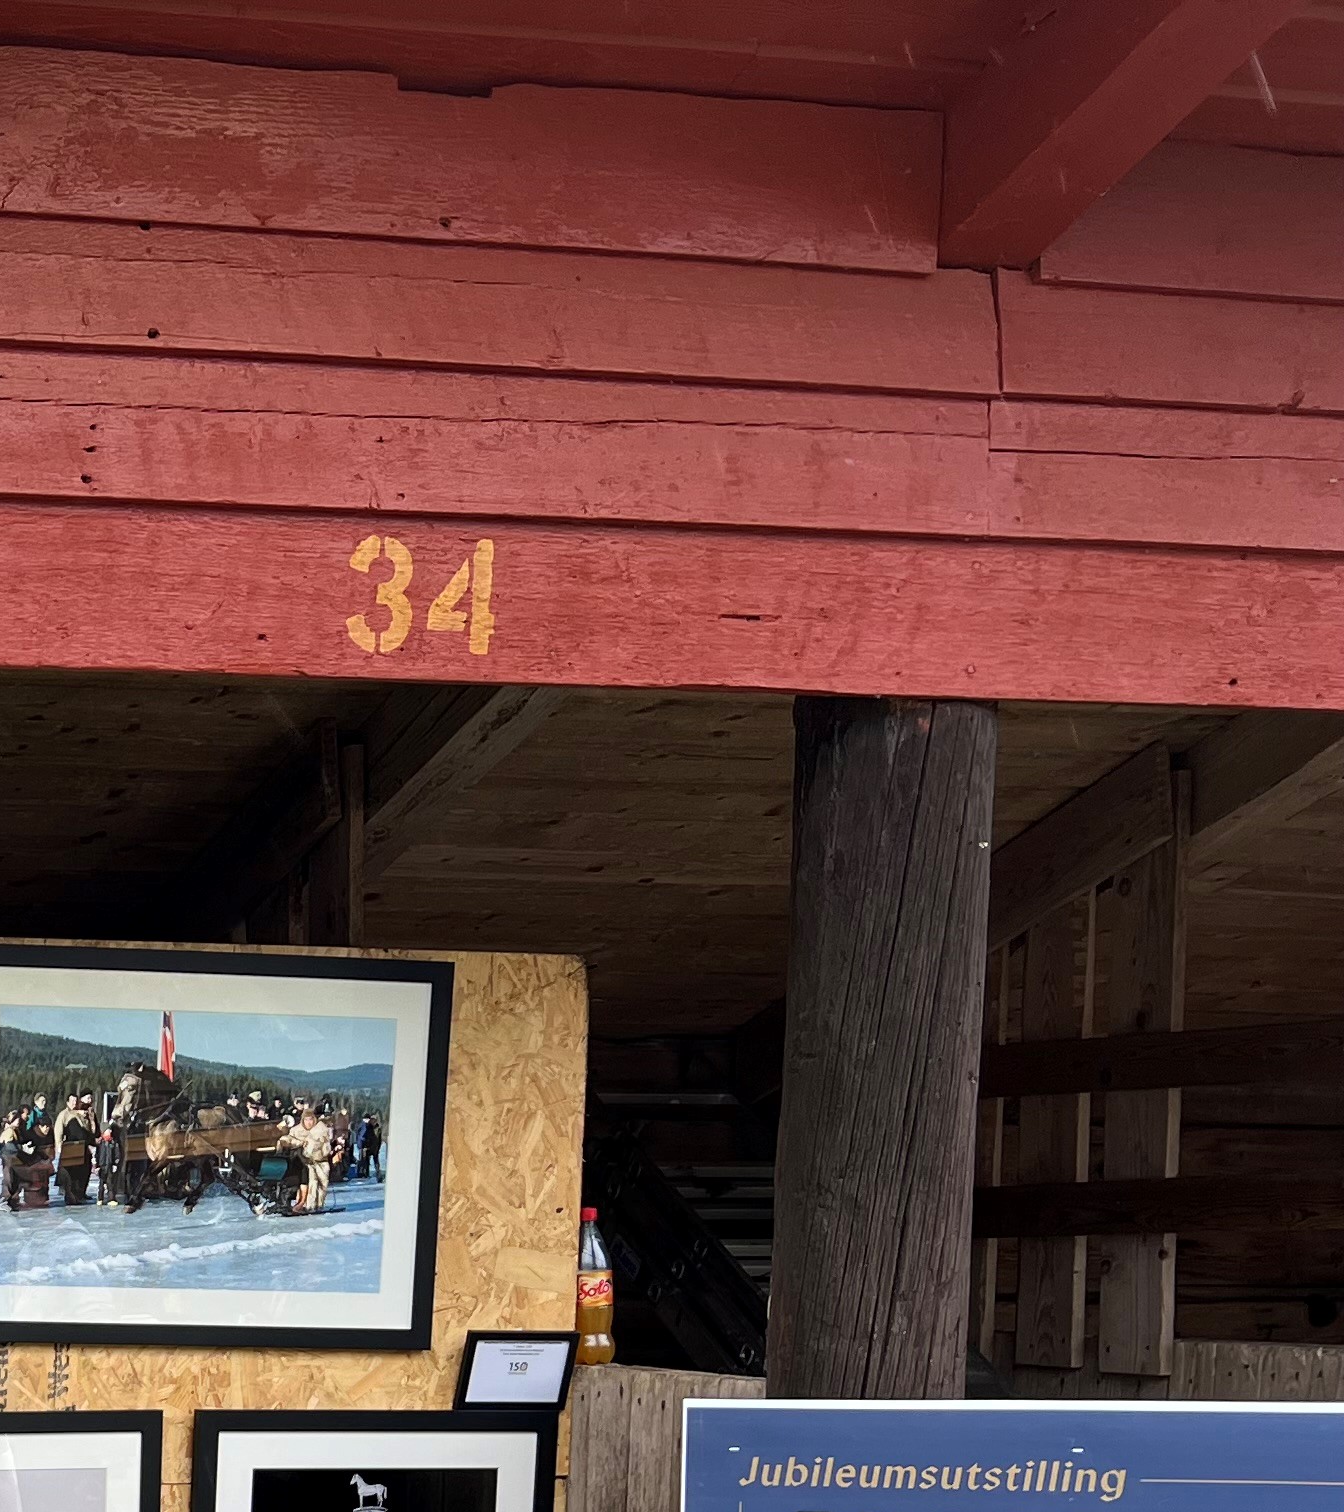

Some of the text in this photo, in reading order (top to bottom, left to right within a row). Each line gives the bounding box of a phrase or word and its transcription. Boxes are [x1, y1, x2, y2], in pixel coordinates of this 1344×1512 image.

[345, 534, 495, 655] 34
[577, 1279, 610, 1300] Solo
[739, 1456, 1126, 1501] Jubileumsutstilling
